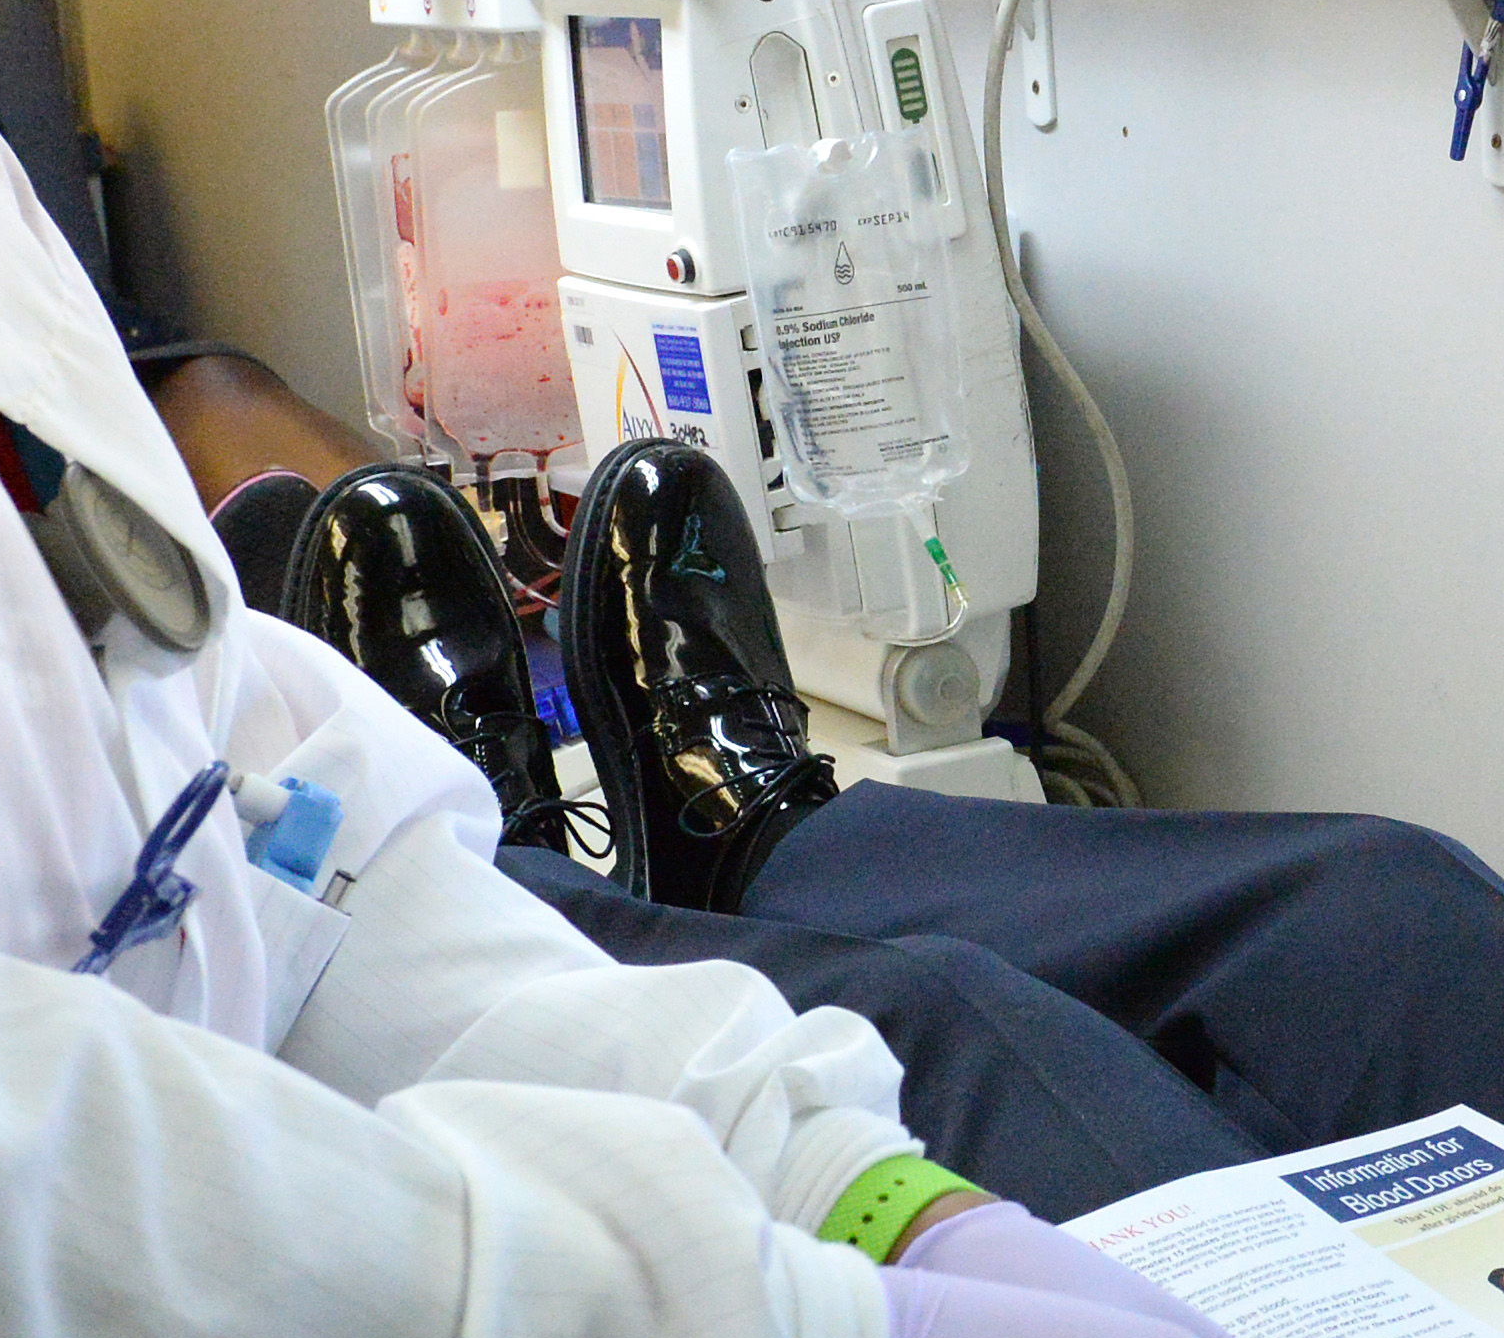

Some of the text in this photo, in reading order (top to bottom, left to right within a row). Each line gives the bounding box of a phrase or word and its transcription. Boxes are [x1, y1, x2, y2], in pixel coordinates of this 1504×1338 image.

[874, 212, 911, 226] SEP14
[802, 320, 838, 333] Sodium
[839, 312, 875, 327] Chloride
[778, 332, 841, 351] Injection USP
[669, 422, 710, 447] 30482
[1303, 1136, 1465, 1193] Information for
[1339, 1158, 1495, 1215] Blood Donors
[1393, 1213, 1429, 1227] What
[1427, 1203, 1454, 1219] YOU
[1453, 1191, 1488, 1208] should
[1446, 1207, 1477, 1226] giving
[1089, 1204, 1196, 1253] ANK YOU!
